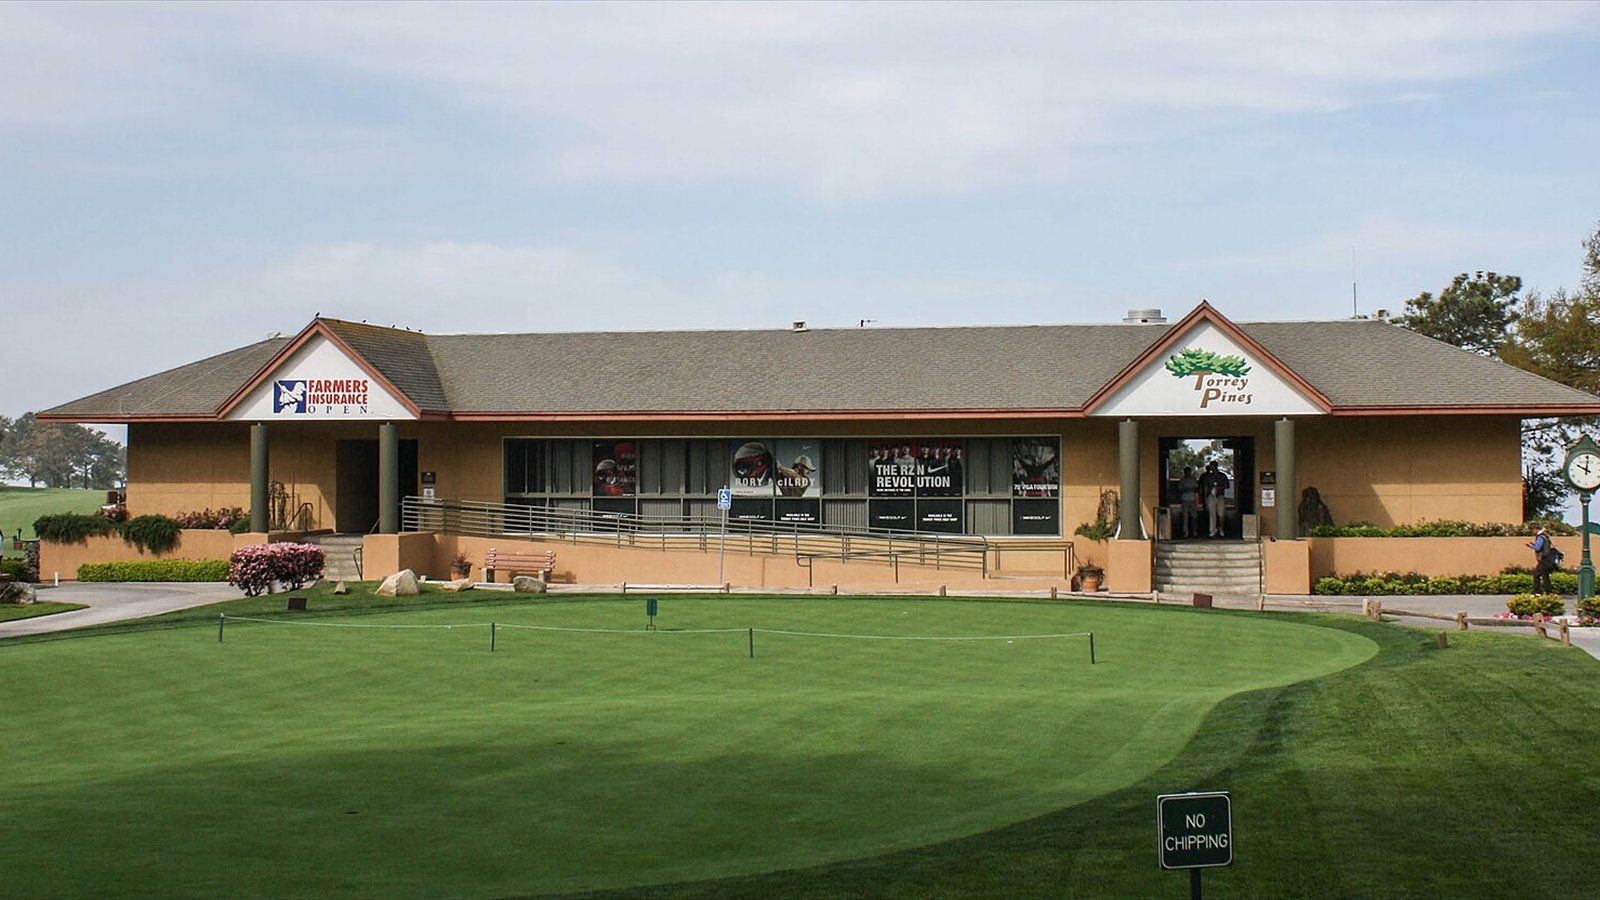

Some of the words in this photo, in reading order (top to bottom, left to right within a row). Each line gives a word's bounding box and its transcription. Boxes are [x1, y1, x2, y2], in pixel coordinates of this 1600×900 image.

[308, 379, 369, 393] FARMERS
[1191, 371, 1249, 391] Torrey
[308, 394, 368, 405] INSURANCE
[1199, 388, 1253, 408] Pines
[307, 405, 368, 414] OPEN
[876, 464, 898, 476] THE
[900, 464, 925, 476] RZN
[735, 477, 763, 487] RORY
[876, 476, 951, 488] REVOLUTION
[1185, 813, 1206, 828] NO
[1165, 833, 1228, 851] CHIPPING
